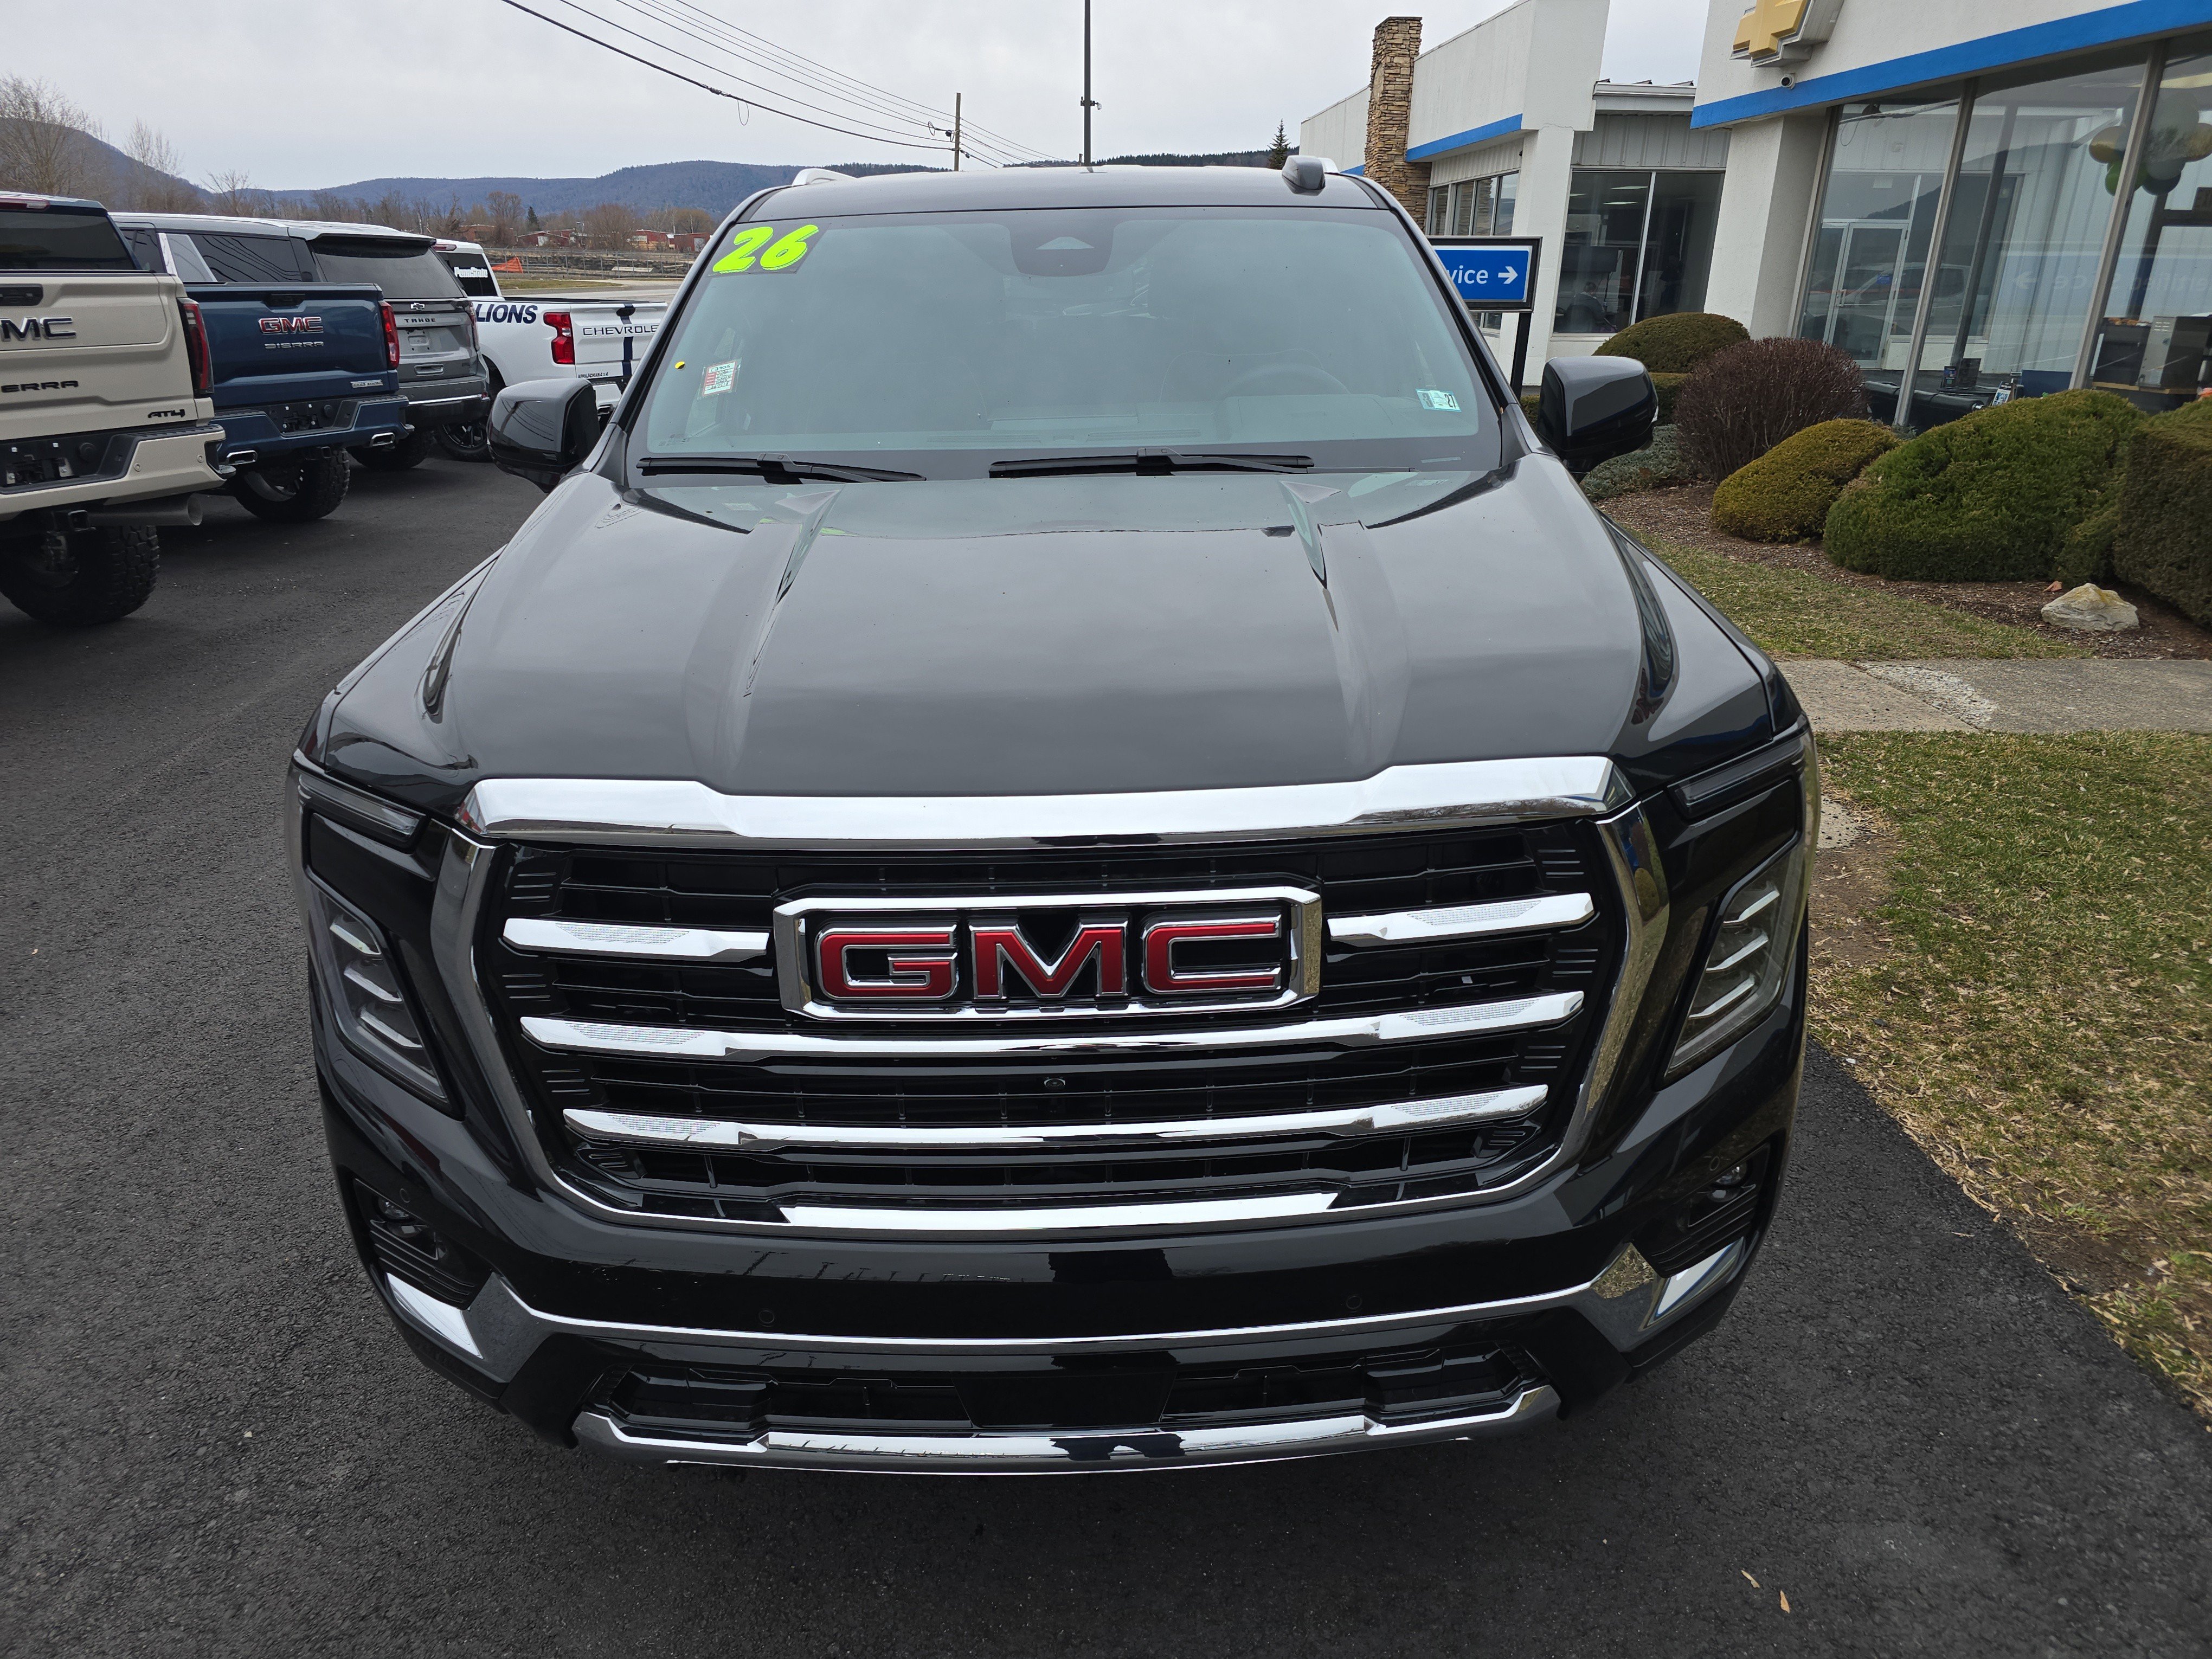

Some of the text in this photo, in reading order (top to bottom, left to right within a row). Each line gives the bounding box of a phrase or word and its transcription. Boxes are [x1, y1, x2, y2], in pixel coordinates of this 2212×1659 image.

[712, 224, 819, 274] 26
[475, 304, 538, 324] LIONS
[0, 317, 76, 342] MC
[259, 317, 324, 335] GMC
[1, 380, 79, 393] ERRA
[1444, 394, 1456, 409] 27
[147, 409, 186, 419] AT4
[815, 912, 1283, 1000] GMC
